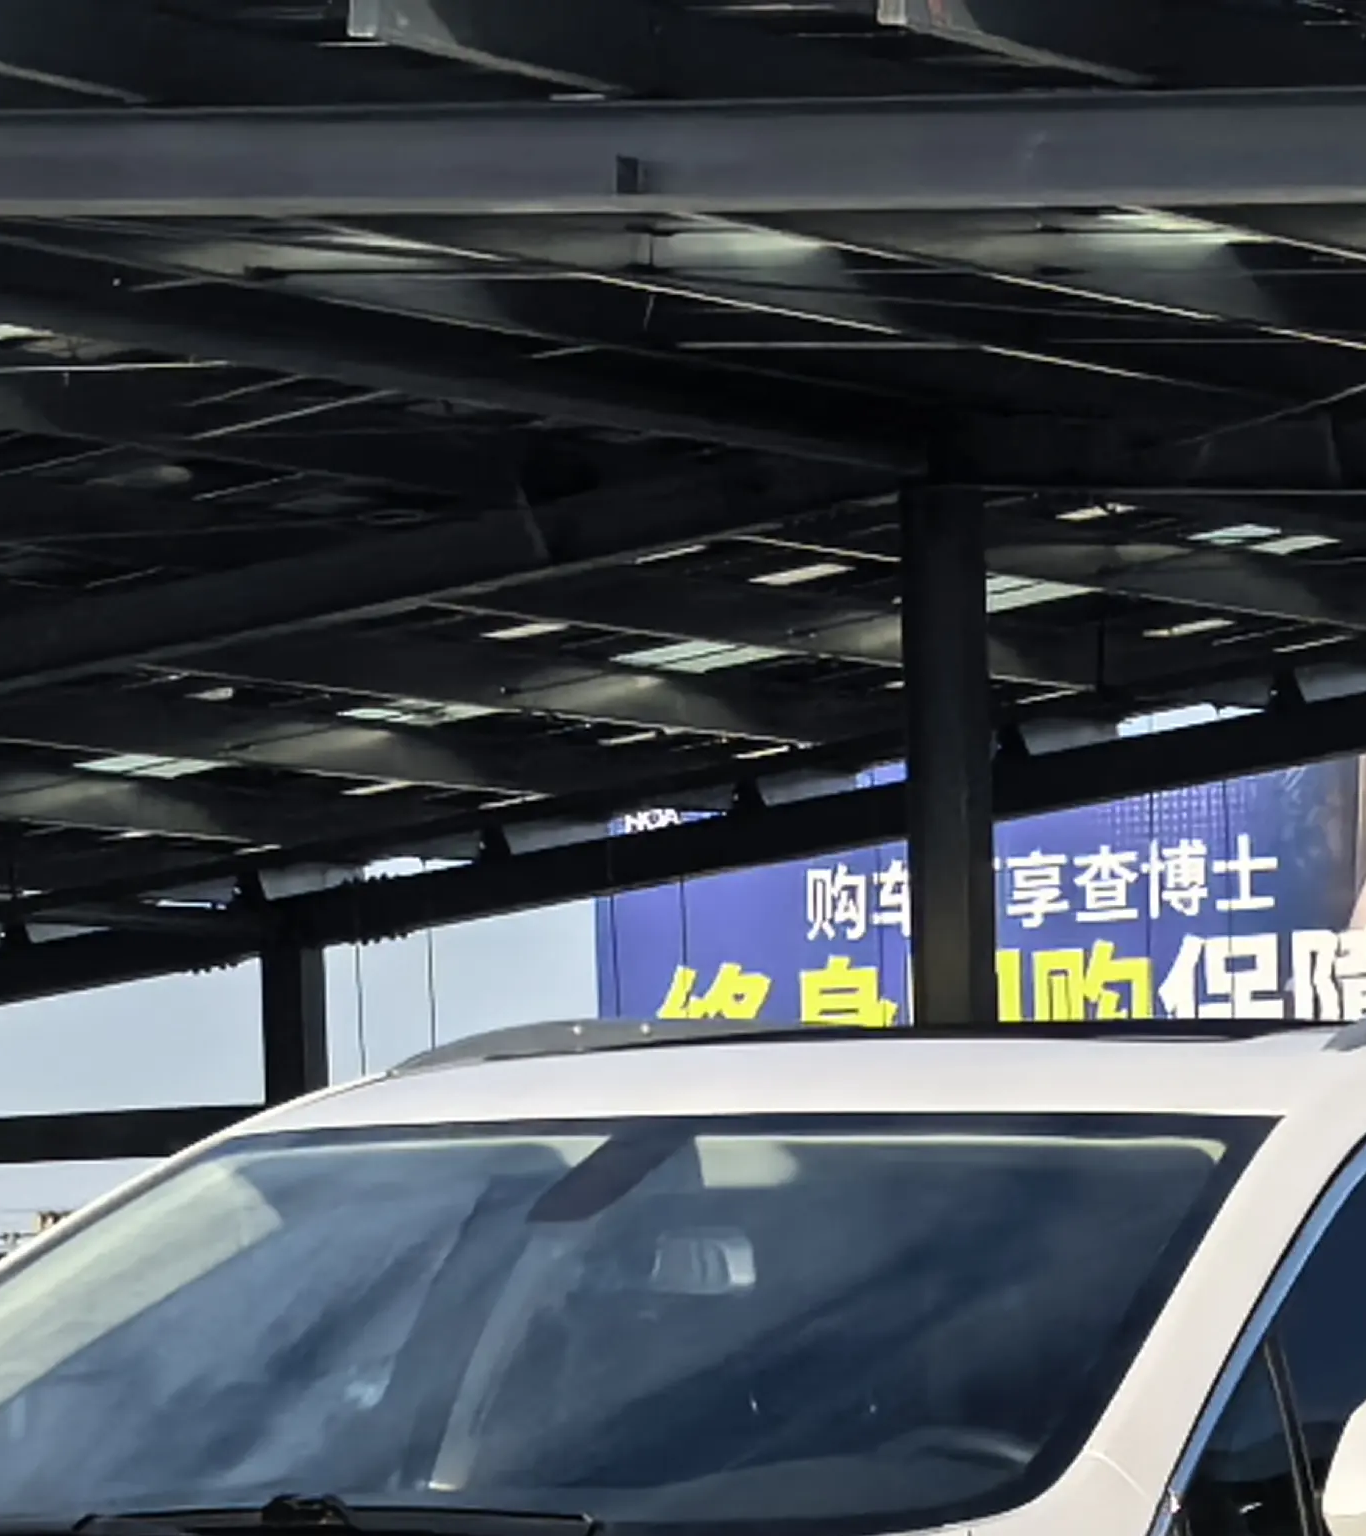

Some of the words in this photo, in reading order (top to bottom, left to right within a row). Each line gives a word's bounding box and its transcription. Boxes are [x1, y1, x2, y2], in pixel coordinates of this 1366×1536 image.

[805, 833, 1278, 941] 购车享查博士
